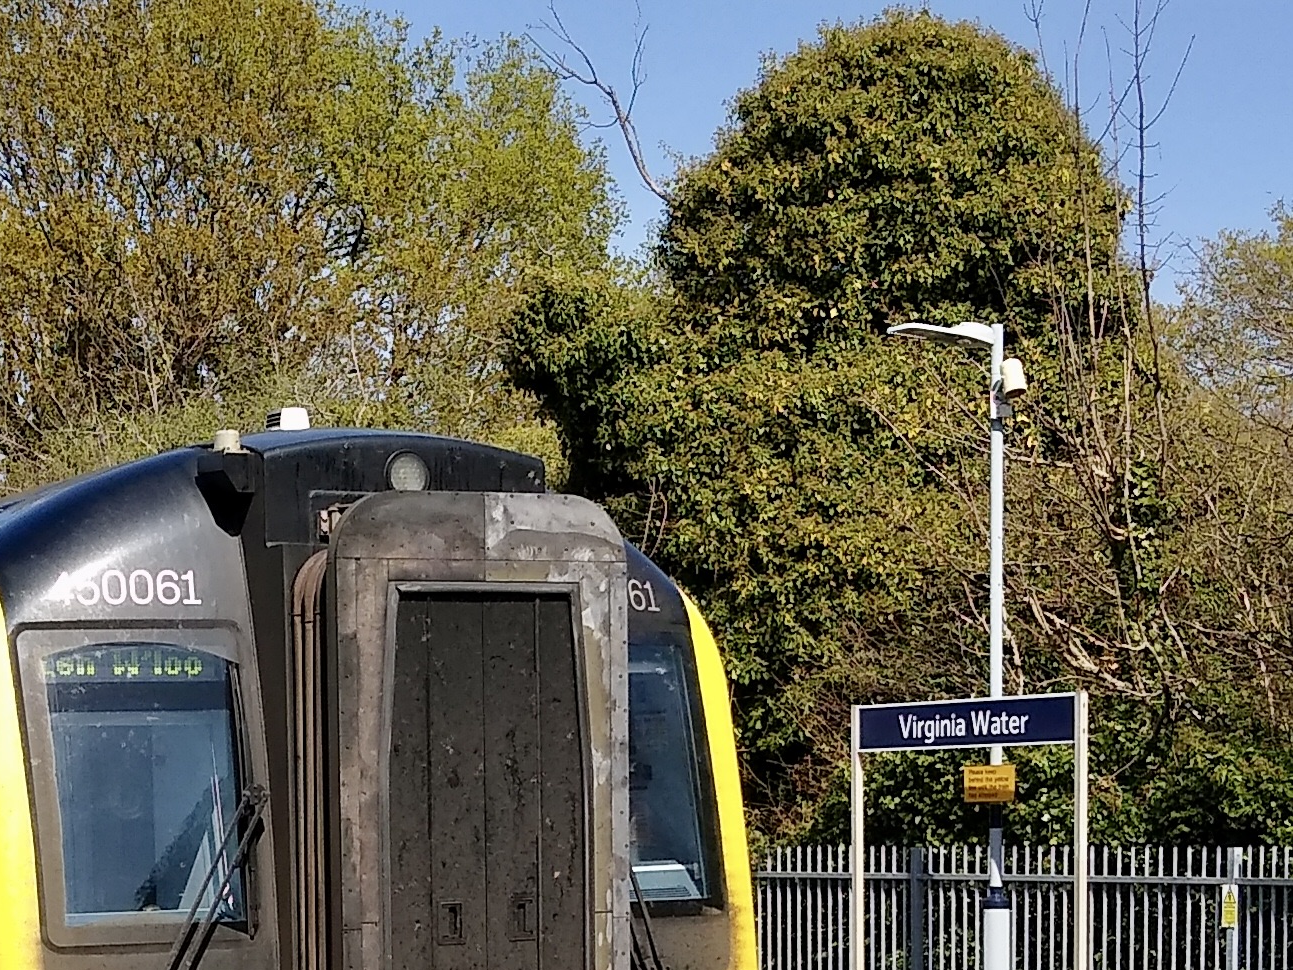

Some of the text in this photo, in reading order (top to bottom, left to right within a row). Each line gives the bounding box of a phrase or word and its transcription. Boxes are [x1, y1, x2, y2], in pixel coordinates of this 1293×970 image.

[47, 569, 202, 606] 450061
[898, 709, 1029, 744] Virginia Water
